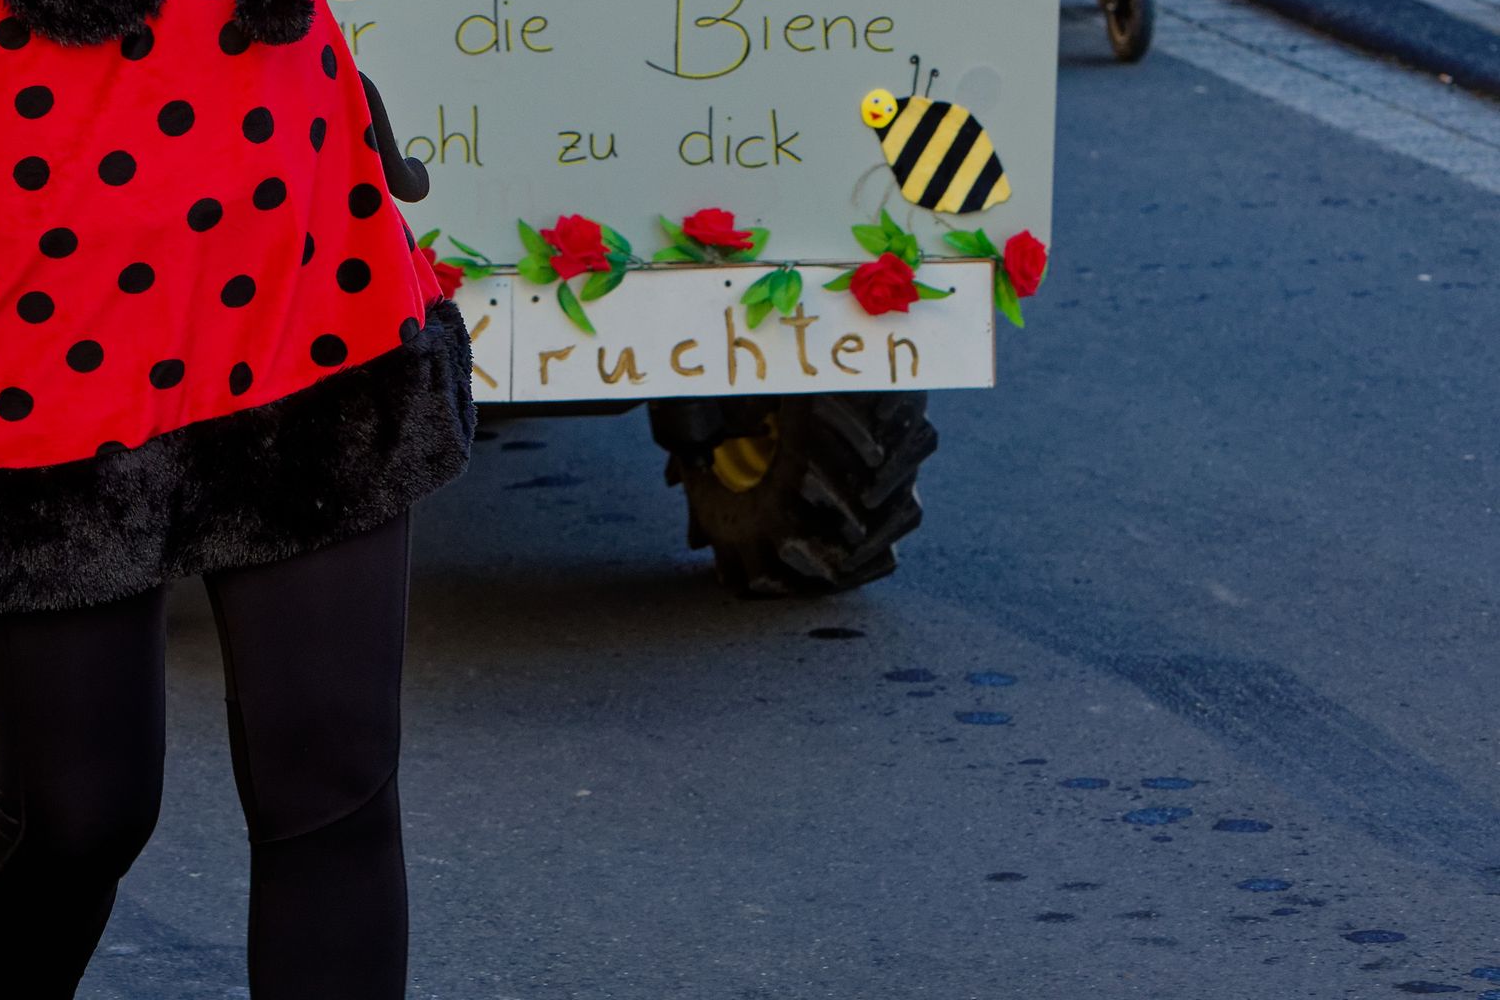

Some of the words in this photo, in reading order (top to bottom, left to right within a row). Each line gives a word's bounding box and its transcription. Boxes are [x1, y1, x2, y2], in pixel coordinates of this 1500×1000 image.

[403, 104, 484, 168] ohl
[556, 129, 619, 165] zu
[679, 106, 804, 169] dick
